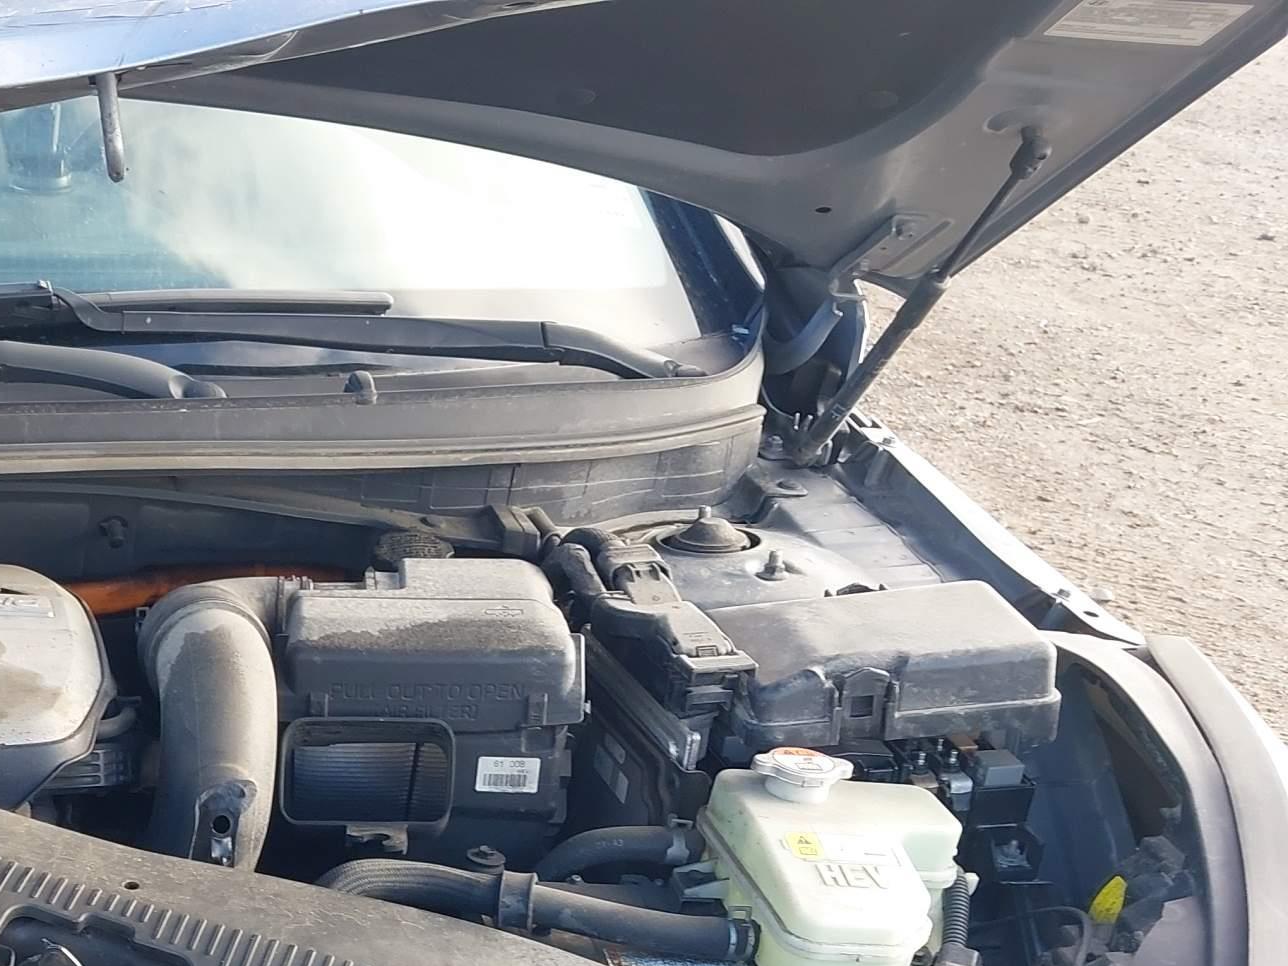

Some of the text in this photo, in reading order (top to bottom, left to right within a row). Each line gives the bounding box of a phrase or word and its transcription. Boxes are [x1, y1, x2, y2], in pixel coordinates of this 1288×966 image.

[386, 683, 433, 701] OUT
[433, 683, 462, 701] TO
[466, 682, 526, 701] OPEN
[813, 864, 890, 890] HEV
